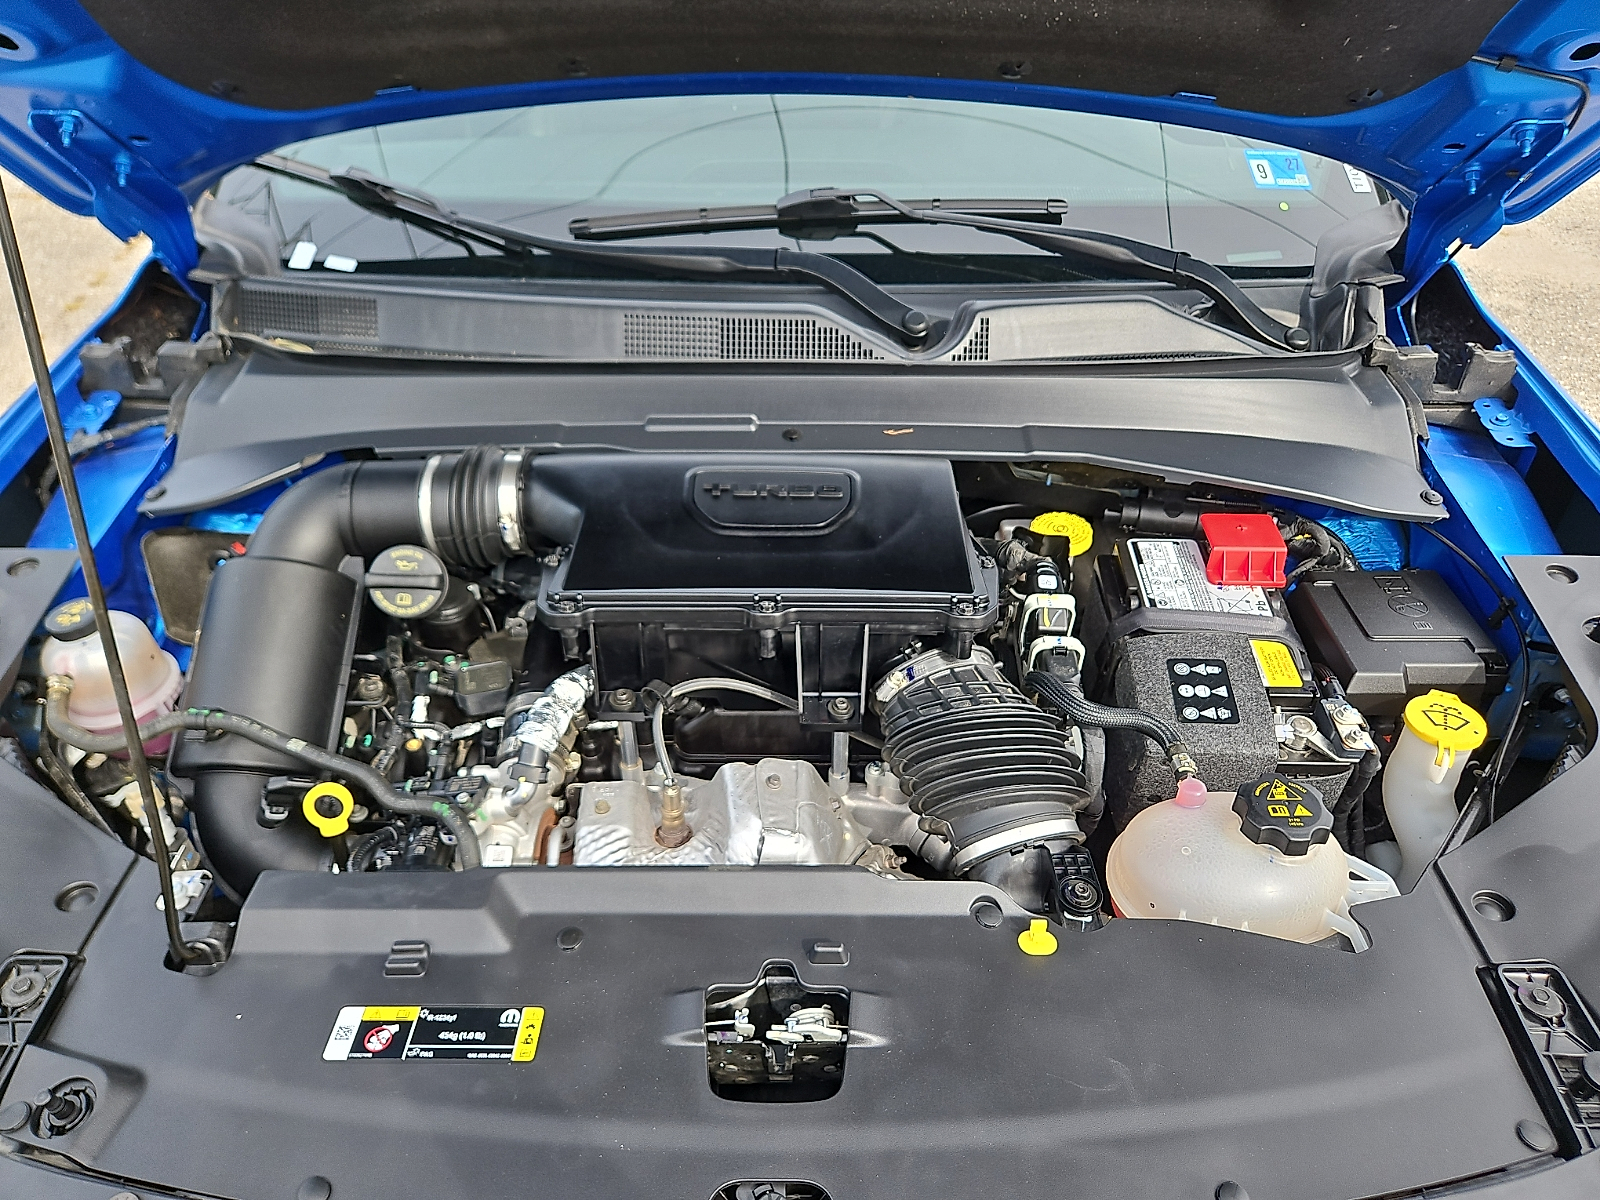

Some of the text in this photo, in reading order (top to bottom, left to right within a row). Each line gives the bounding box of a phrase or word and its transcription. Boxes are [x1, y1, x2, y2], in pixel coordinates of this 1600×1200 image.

[1256, 163, 1268, 179] 9
[1285, 158, 1300, 171] 27
[1255, 600, 1269, 611] Pb
